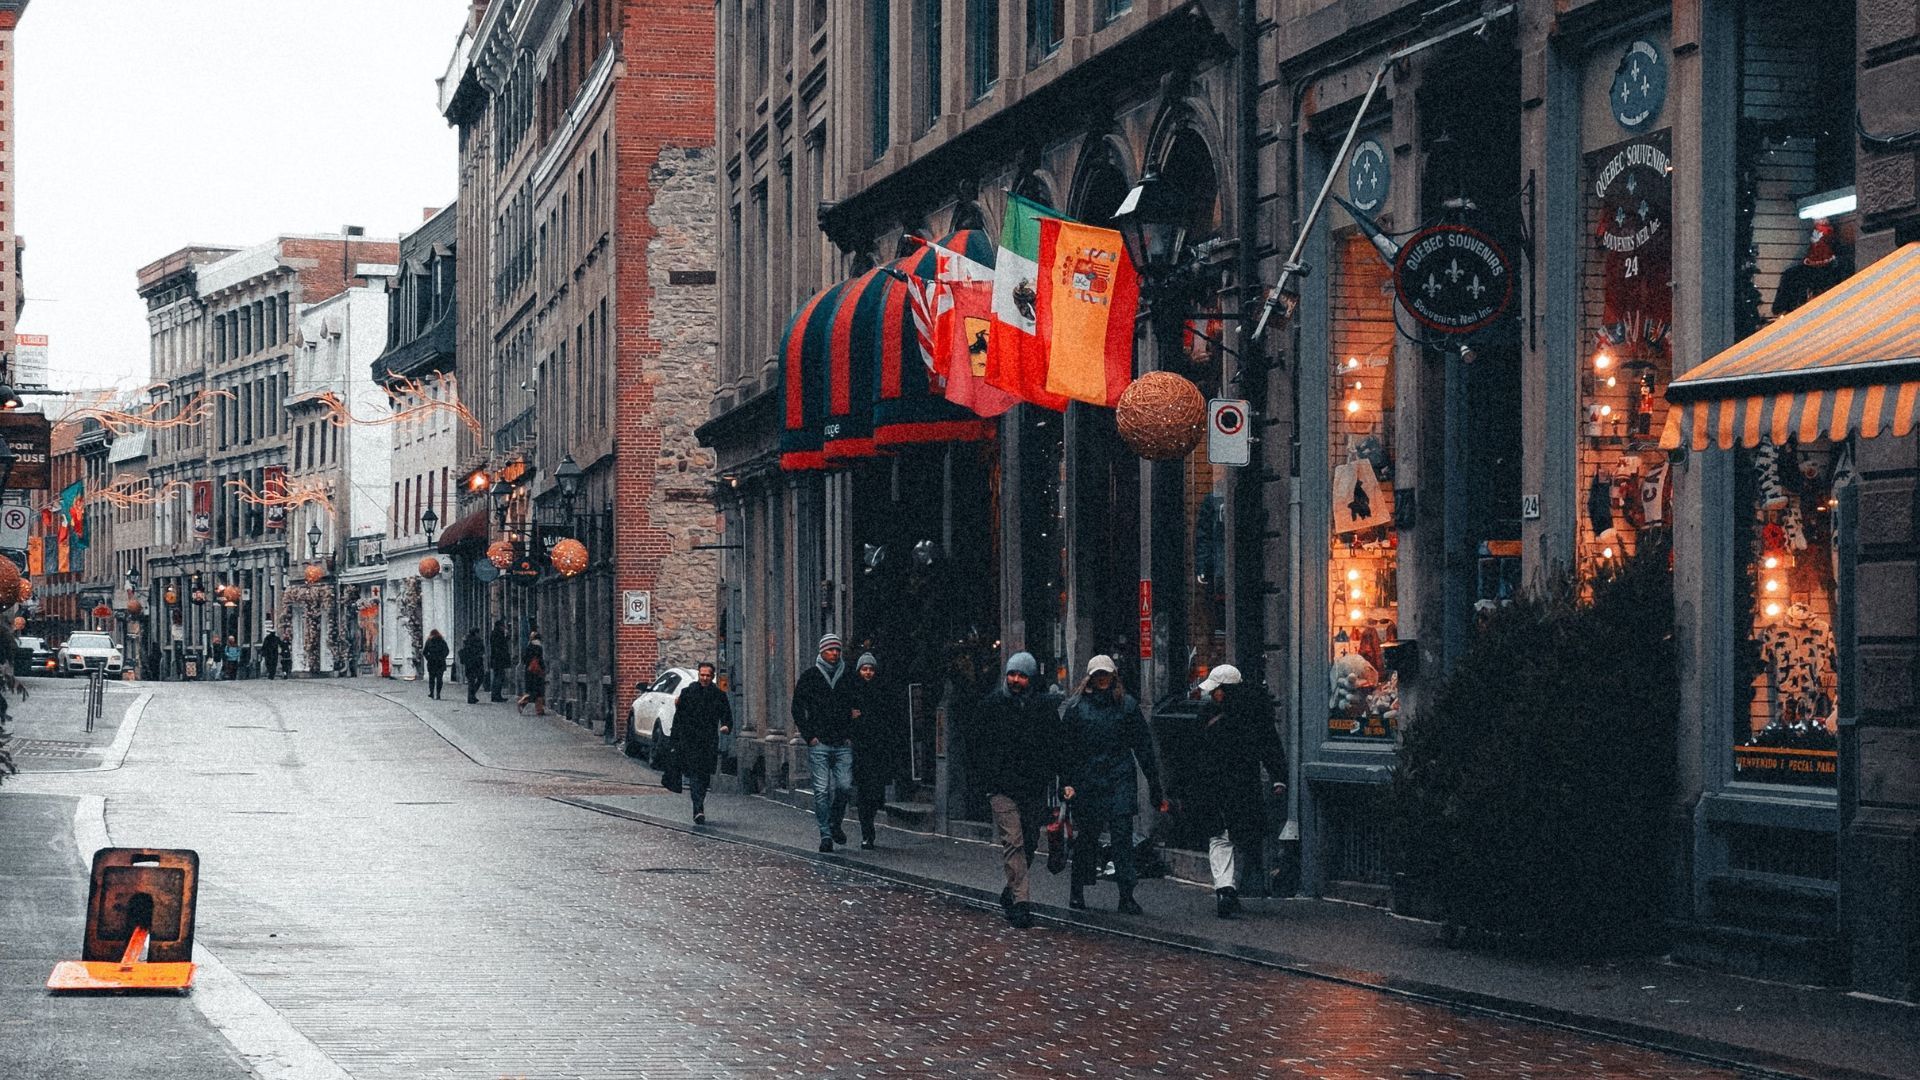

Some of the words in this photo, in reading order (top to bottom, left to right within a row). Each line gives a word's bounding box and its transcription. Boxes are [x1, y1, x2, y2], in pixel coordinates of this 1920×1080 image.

[1596, 151, 1625, 198] QUEBEC
[1626, 144, 1671, 178] SOUVENIRS
[1602, 231, 1636, 252] SOUVENIRS
[1448, 234, 1504, 277] SOUVENIRS
[1625, 255, 1639, 279] 24
[1414, 298, 1457, 326] Souvenirs
[15, 453, 46, 463] OUSE
[1524, 497, 1539, 516] 24
